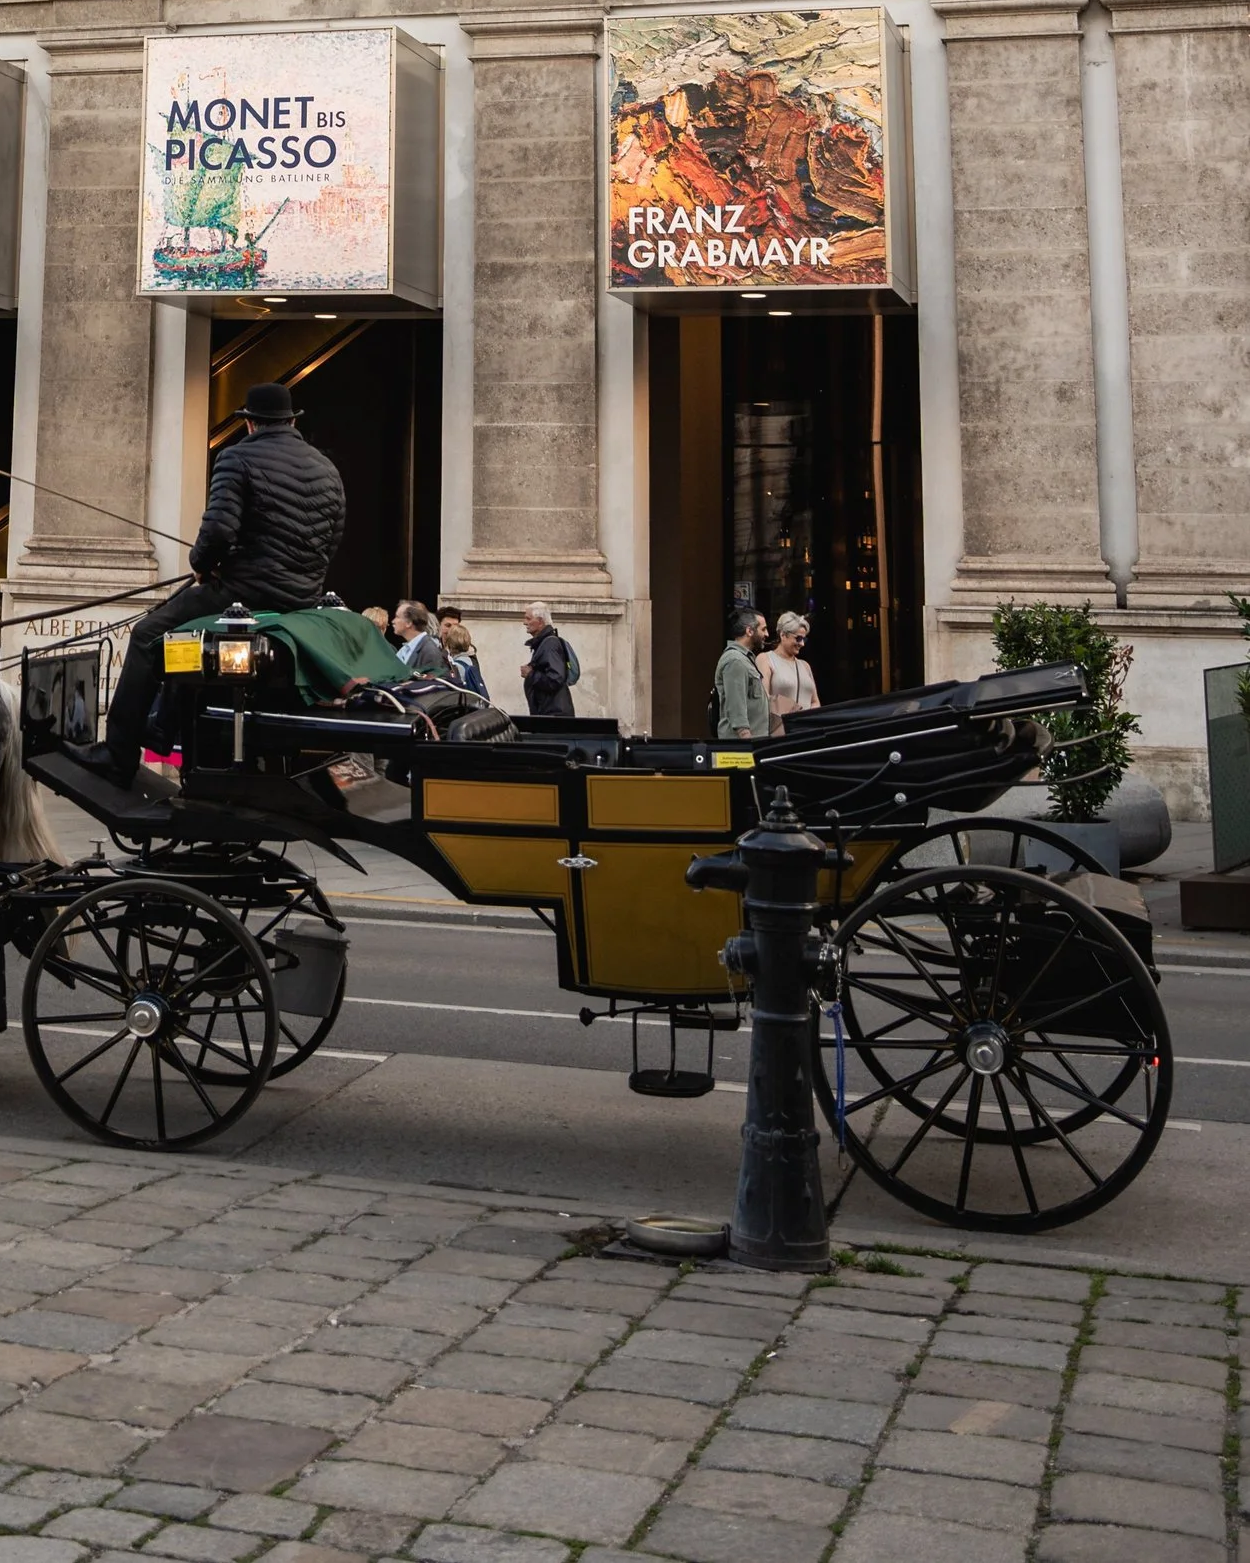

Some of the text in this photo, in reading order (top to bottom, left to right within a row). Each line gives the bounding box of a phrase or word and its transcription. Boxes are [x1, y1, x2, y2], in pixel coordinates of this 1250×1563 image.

[167, 96, 346, 133] MONET BIS
[165, 134, 337, 171] PICASSO
[164, 173, 330, 185] DIE SAMMLUNG BATLINER
[628, 204, 745, 235] FRANZ
[627, 237, 831, 269] GRABMAYR
[23, 618, 133, 640] ALBERTINA
